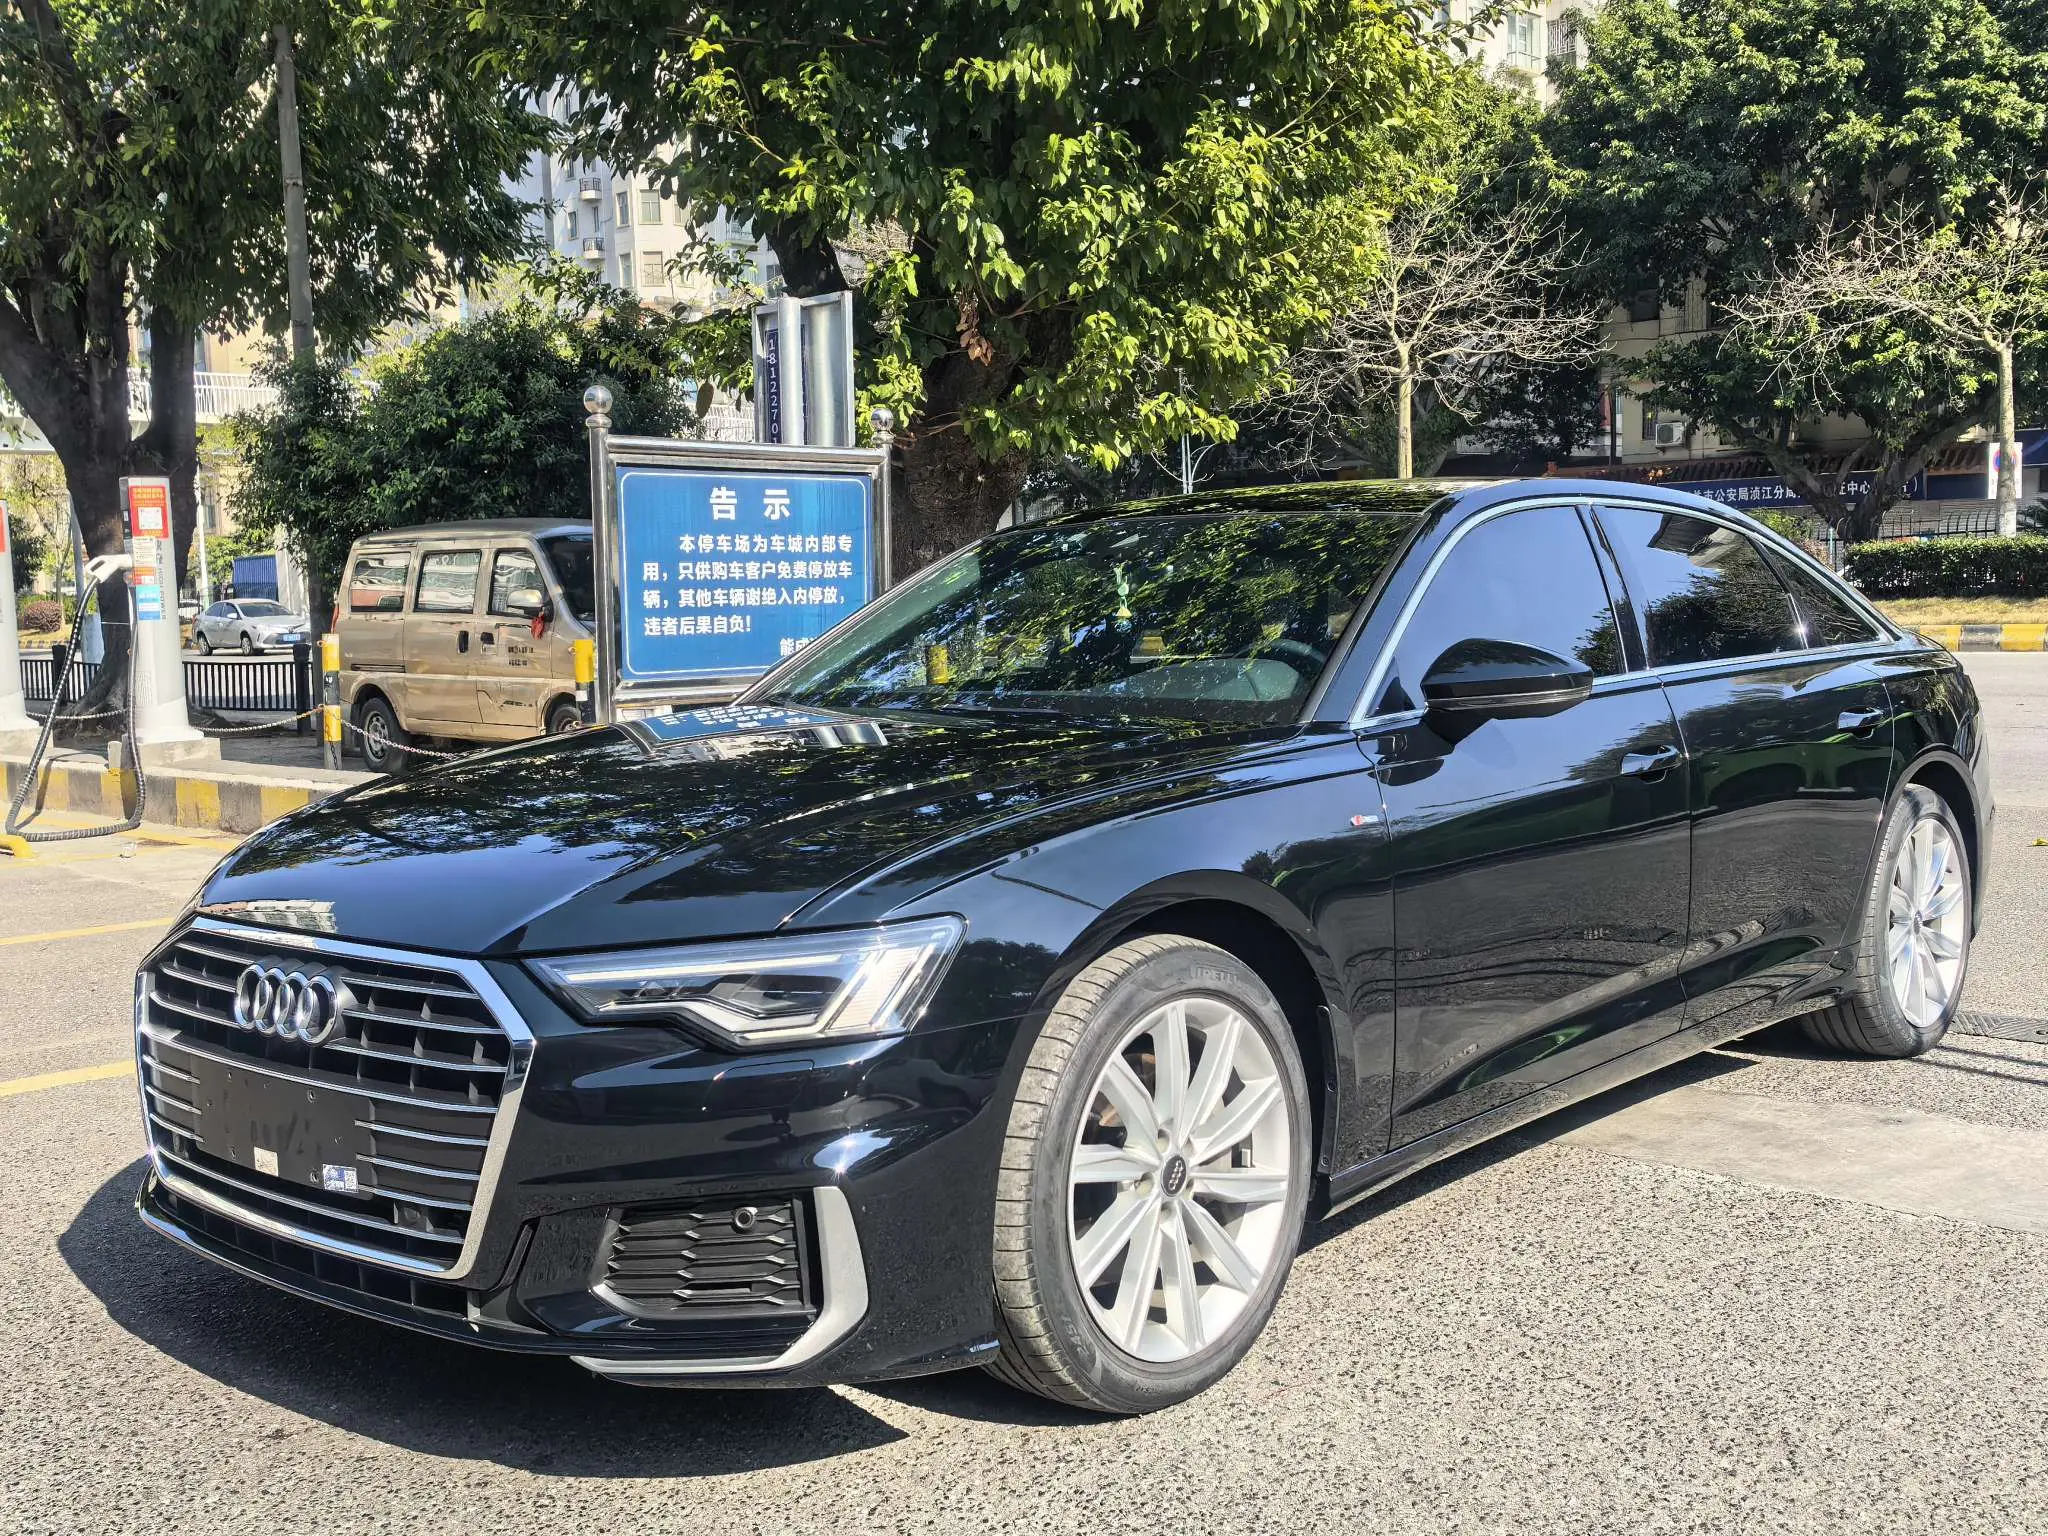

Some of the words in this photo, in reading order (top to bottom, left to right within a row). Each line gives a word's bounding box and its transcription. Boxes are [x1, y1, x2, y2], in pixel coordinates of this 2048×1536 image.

[709, 486, 791, 521] 告示
[679, 533, 853, 554] 本停车场为车城内部专
